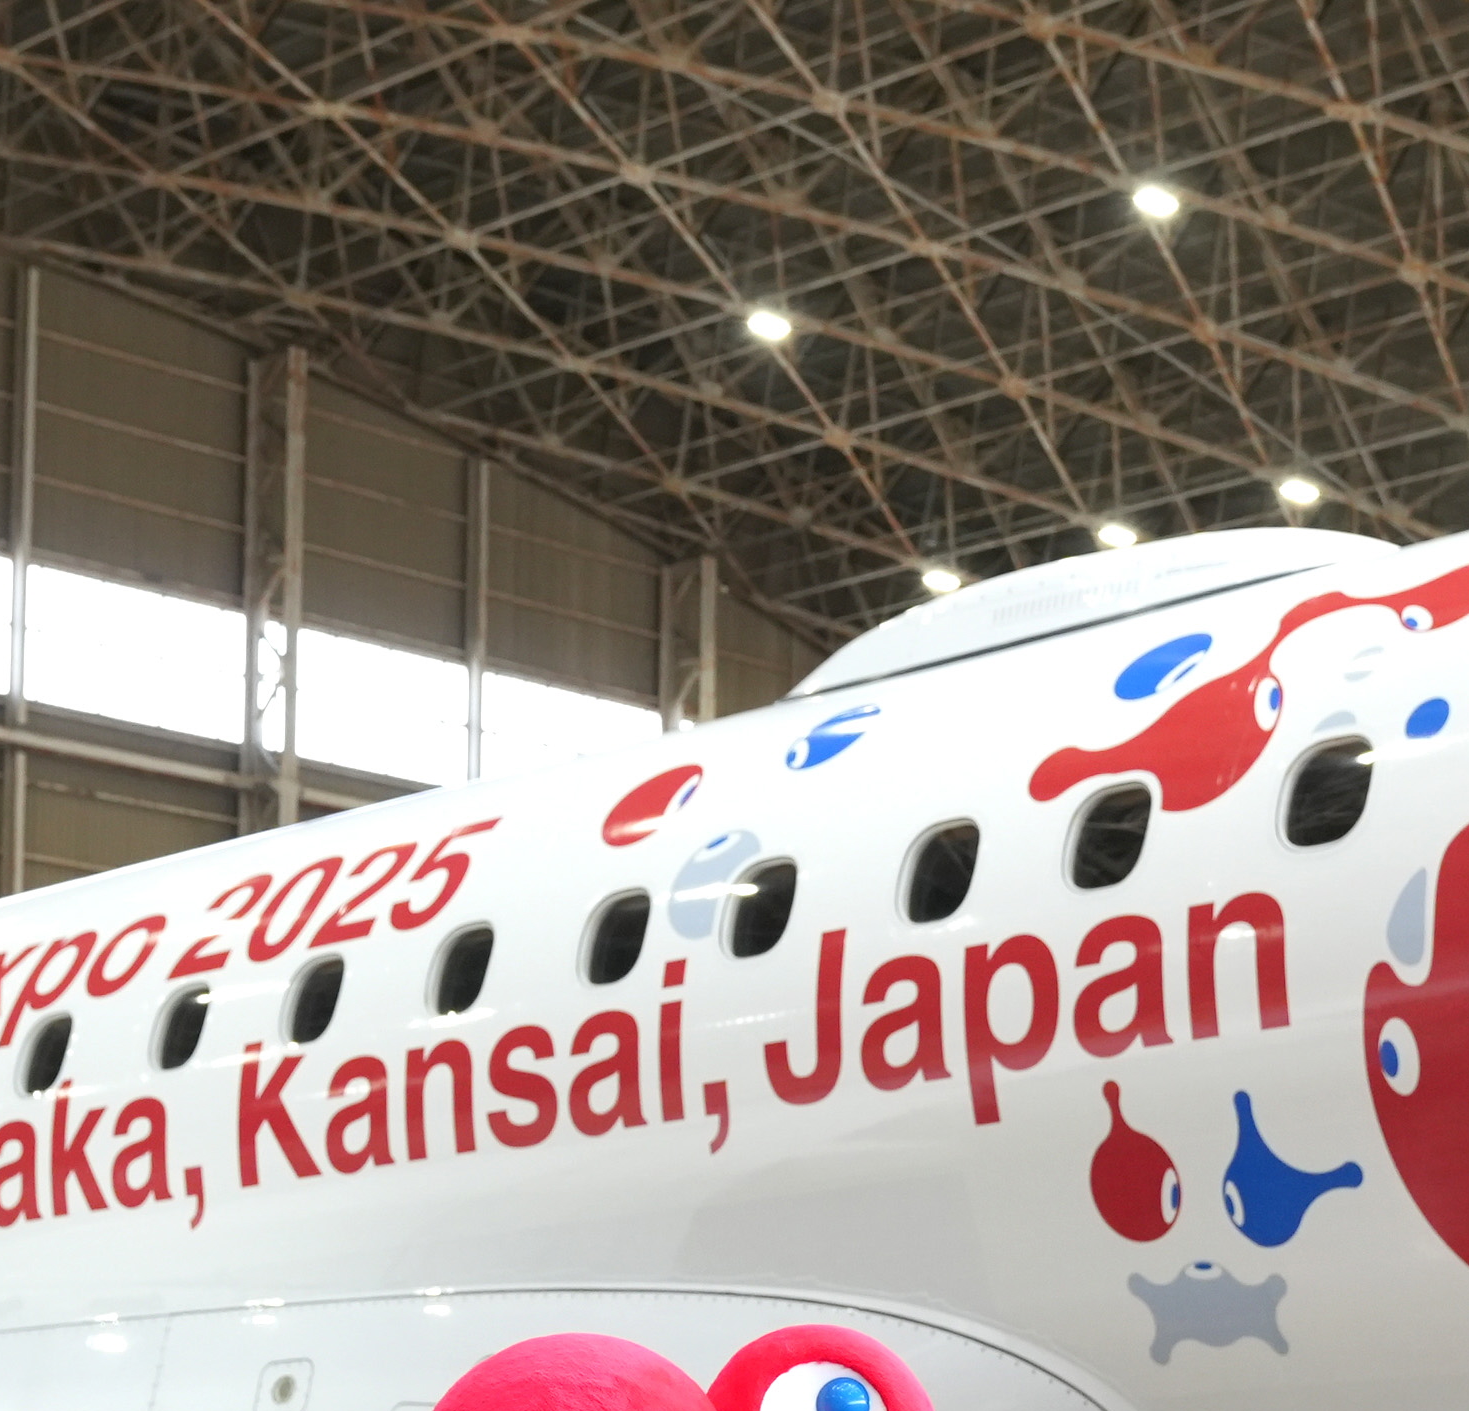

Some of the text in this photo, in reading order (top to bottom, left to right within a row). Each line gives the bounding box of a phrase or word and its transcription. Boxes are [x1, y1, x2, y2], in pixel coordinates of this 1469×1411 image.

[168, 817, 501, 980] 2025
[237, 957, 731, 1154] Kansai,
[763, 891, 1292, 1127] Japan
